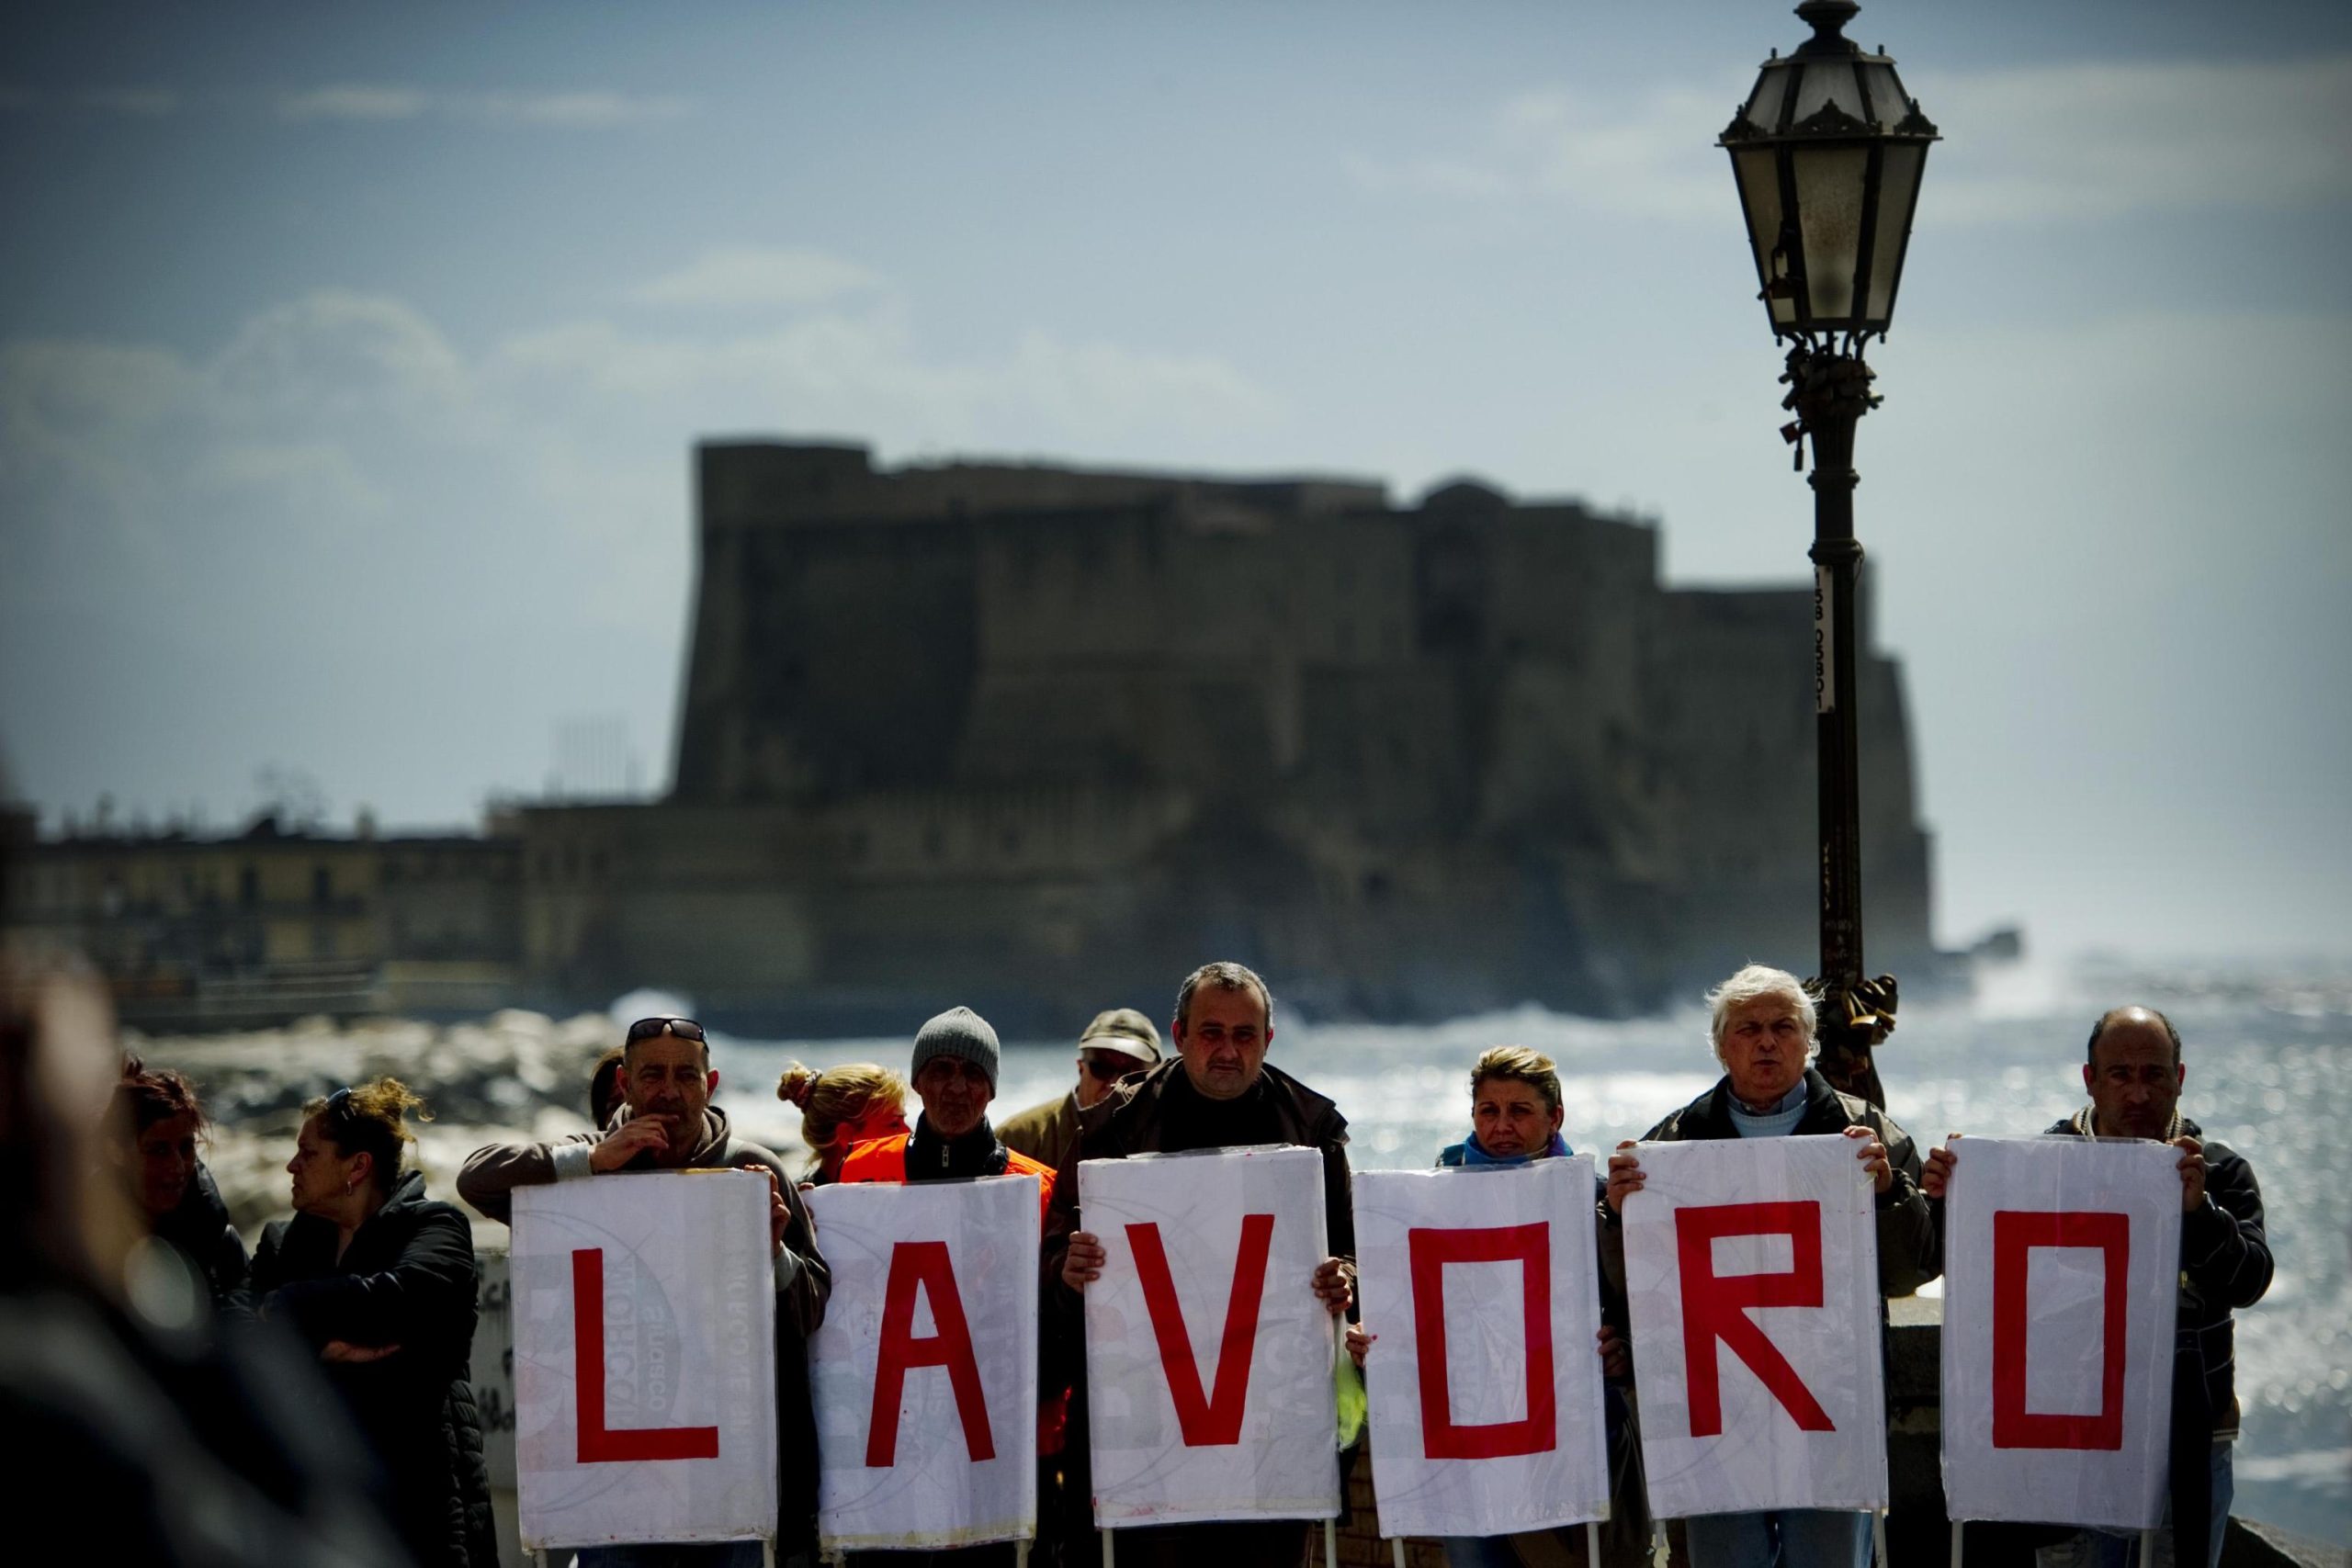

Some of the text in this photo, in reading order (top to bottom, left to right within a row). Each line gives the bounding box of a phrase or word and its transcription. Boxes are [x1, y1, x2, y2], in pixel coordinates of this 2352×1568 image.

[572, 1248, 718, 1462] L
[865, 1242, 997, 1467] A
[1125, 1214, 1274, 1447] V
[1408, 1222, 1555, 1459] O
[1675, 1201, 1834, 1437] R
[1993, 1211, 2129, 1451] O
